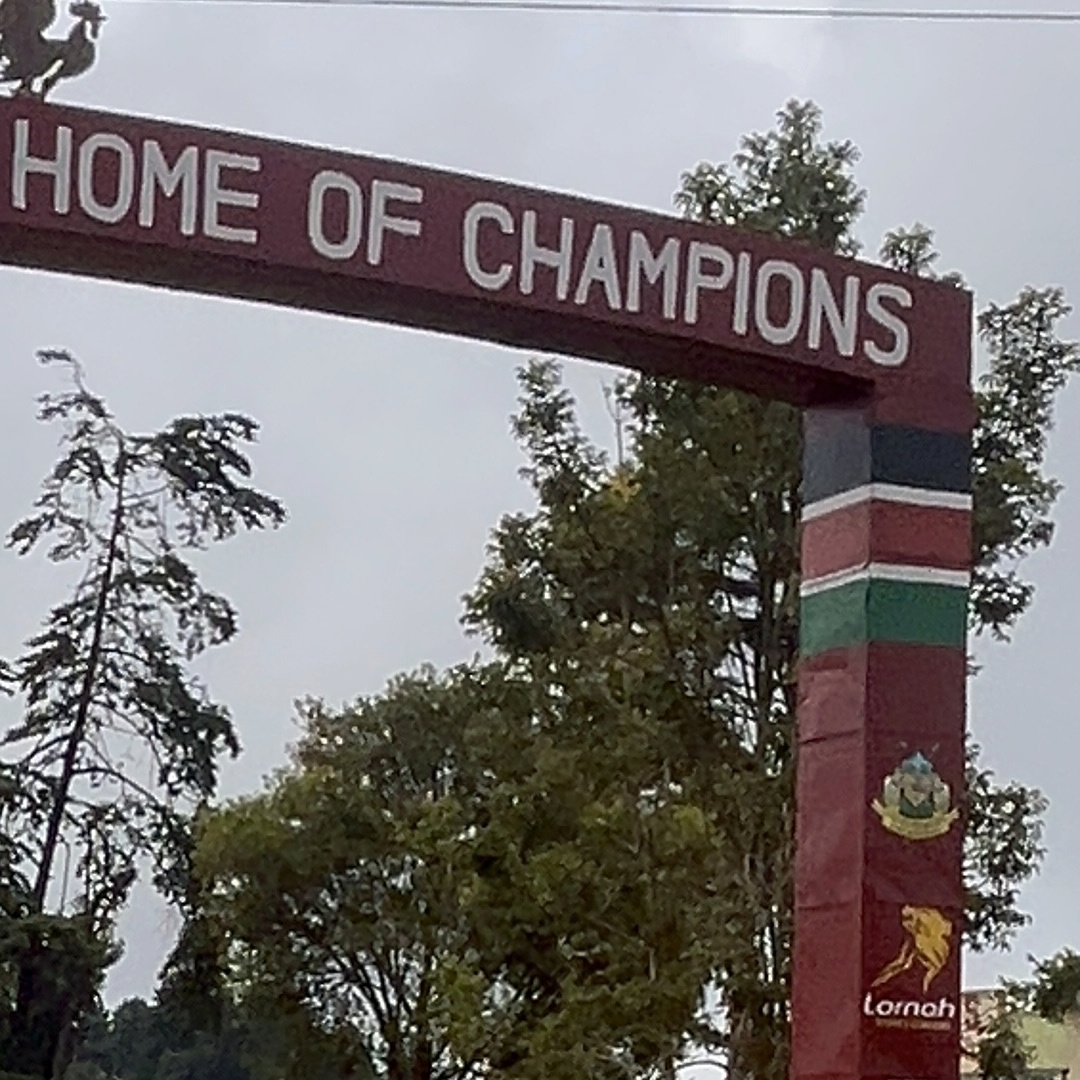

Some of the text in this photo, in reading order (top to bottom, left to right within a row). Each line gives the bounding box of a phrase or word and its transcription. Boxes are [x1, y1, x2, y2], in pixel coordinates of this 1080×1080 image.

[11, 118, 261, 244] HOME
[307, 170, 423, 265] OF
[462, 202, 914, 367] CHAMPIONS
[863, 991, 956, 1018] Lornah
